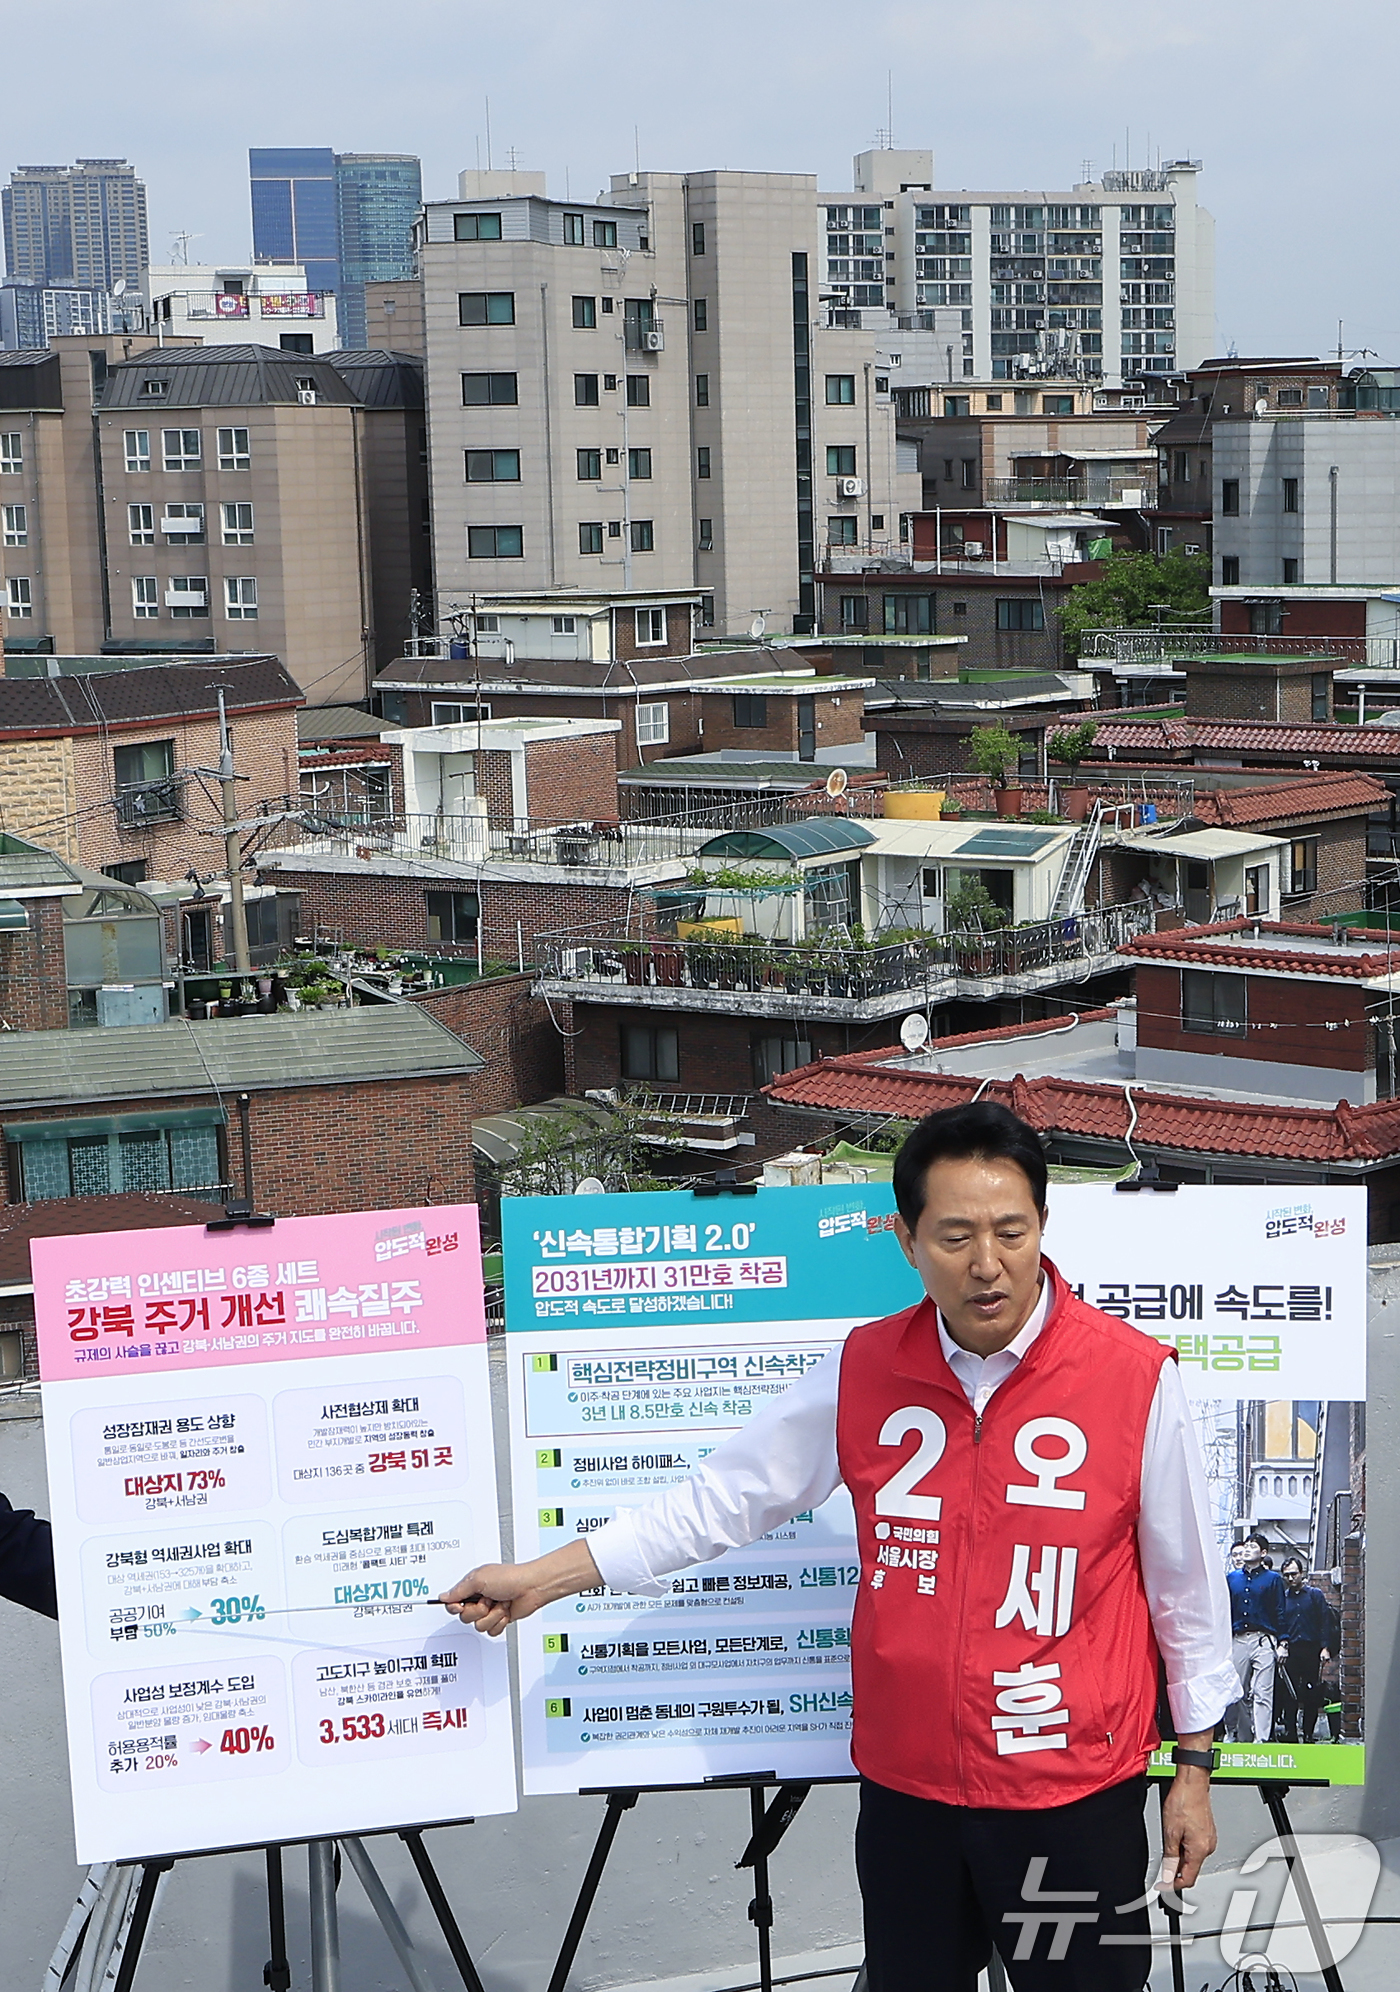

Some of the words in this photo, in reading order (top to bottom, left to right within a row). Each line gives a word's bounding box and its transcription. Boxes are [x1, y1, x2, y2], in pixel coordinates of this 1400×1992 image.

[818, 1209, 867, 1239] 압도적
[1265, 1215, 1313, 1239] 압도적
[1314, 1217, 1346, 1239] 완성
[374, 1231, 426, 1263] 압도적
[425, 1232, 459, 1257] 완성
[65, 1275, 132, 1304] 초강력
[137, 1268, 228, 1298] 인센티브
[232, 1264, 269, 1289] 6종
[275, 1260, 320, 1286] 세트
[535, 1266, 657, 1294] 2031년까지
[664, 1263, 733, 1288] 31만호
[739, 1260, 783, 1285] 착공
[67, 1303, 135, 1342] 강북
[144, 1297, 210, 1335] 주거
[220, 1291, 286, 1329] 개선
[294, 1280, 424, 1323] 쾌속질주
[535, 1298, 579, 1318] 압도적
[582, 1297, 626, 1316] 속도로
[628, 1293, 733, 1315] 달성하겠습니다!
[1096, 1283, 1203, 1321] 공급에
[1214, 1284, 1333, 1321] 속도를!
[74, 1347, 111, 1363] 규제의
[115, 1344, 151, 1359] 사슬을
[155, 1341, 179, 1356] 끊고
[262, 1332, 287, 1347] 주거
[289, 1328, 326, 1344] 지도를
[328, 1325, 365, 1341] 완전히
[368, 1321, 420, 1338] 바꿉니다.
[1150, 1334, 1283, 1372] 택공급
[572, 1356, 738, 1384] 핵심전략정비구역
[622, 1389, 650, 1401] 단계에
[652, 1387, 671, 1399] 있는
[673, 1388, 692, 1398] 주요
[694, 1386, 731, 1398] 사업지는
[320, 1399, 389, 1420] 사전협상제
[391, 1397, 420, 1413] 확대
[582, 1405, 606, 1422] 3년
[611, 1405, 626, 1421] 내
[630, 1402, 685, 1420] 8.5만호
[689, 1401, 719, 1417] 신속
[722, 1399, 752, 1416] 착공
[102, 1419, 173, 1440] 성장잠재권
[176, 1416, 204, 1433] 용도
[207, 1413, 236, 1429] 상향
[293, 1466, 323, 1480] 대상지
[325, 1463, 353, 1477] 136곳
[354, 1463, 365, 1474] 중
[368, 1450, 407, 1473] 강북
[411, 1448, 429, 1469] 51
[433, 1446, 453, 1467] 곳
[573, 1456, 628, 1473] 정비사업
[632, 1453, 691, 1470] 하이패스,
[875, 1406, 947, 1521] 2
[124, 1472, 183, 1496] 대상지
[186, 1469, 226, 1491] 73%
[145, 1493, 208, 1510] 강북+서남권
[322, 1524, 403, 1546] 도심복합개발
[406, 1520, 434, 1537] 특례
[893, 1526, 940, 1545] 국민의힘
[105, 1550, 148, 1568] 강북형
[151, 1542, 221, 1562] 역세권사업
[223, 1539, 252, 1555] 확대
[877, 1544, 939, 1571] 서울시장
[334, 1581, 388, 1604] 대상지
[391, 1577, 429, 1599] 70%
[672, 1578, 699, 1594] 쉽고
[702, 1576, 729, 1592] 빠른
[733, 1573, 792, 1592] 정보제공,
[991, 1416, 1088, 1756] 오세훈
[109, 1603, 165, 1624] 공공기여
[210, 1594, 266, 1625] 30%
[110, 1624, 139, 1642] 부담
[143, 1622, 177, 1638] 50%
[581, 1642, 649, 1660] 신통기획을
[652, 1639, 712, 1656] 모든사업,
[715, 1635, 788, 1653] 모든단계로,
[316, 1661, 370, 1682] 고도지구
[373, 1655, 428, 1676] 높이규제
[430, 1652, 458, 1669] 혁파
[123, 1685, 165, 1704] 사업성
[169, 1679, 224, 1698] 보정계수
[227, 1675, 255, 1692] 도입
[387, 1716, 419, 1736] 세대
[422, 1707, 468, 1731] 즉시!
[583, 1706, 622, 1723] 사업이
[626, 1705, 652, 1721] 멈춘
[655, 1703, 695, 1720] 동네의
[698, 1699, 764, 1718] 구원투수가
[108, 1734, 178, 1757] 허용용적률
[220, 1724, 275, 1756] 40%
[110, 1757, 139, 1775] 추가
[145, 1753, 178, 1771] 20%
[1220, 1754, 1297, 1769] 만들겠습니다.
